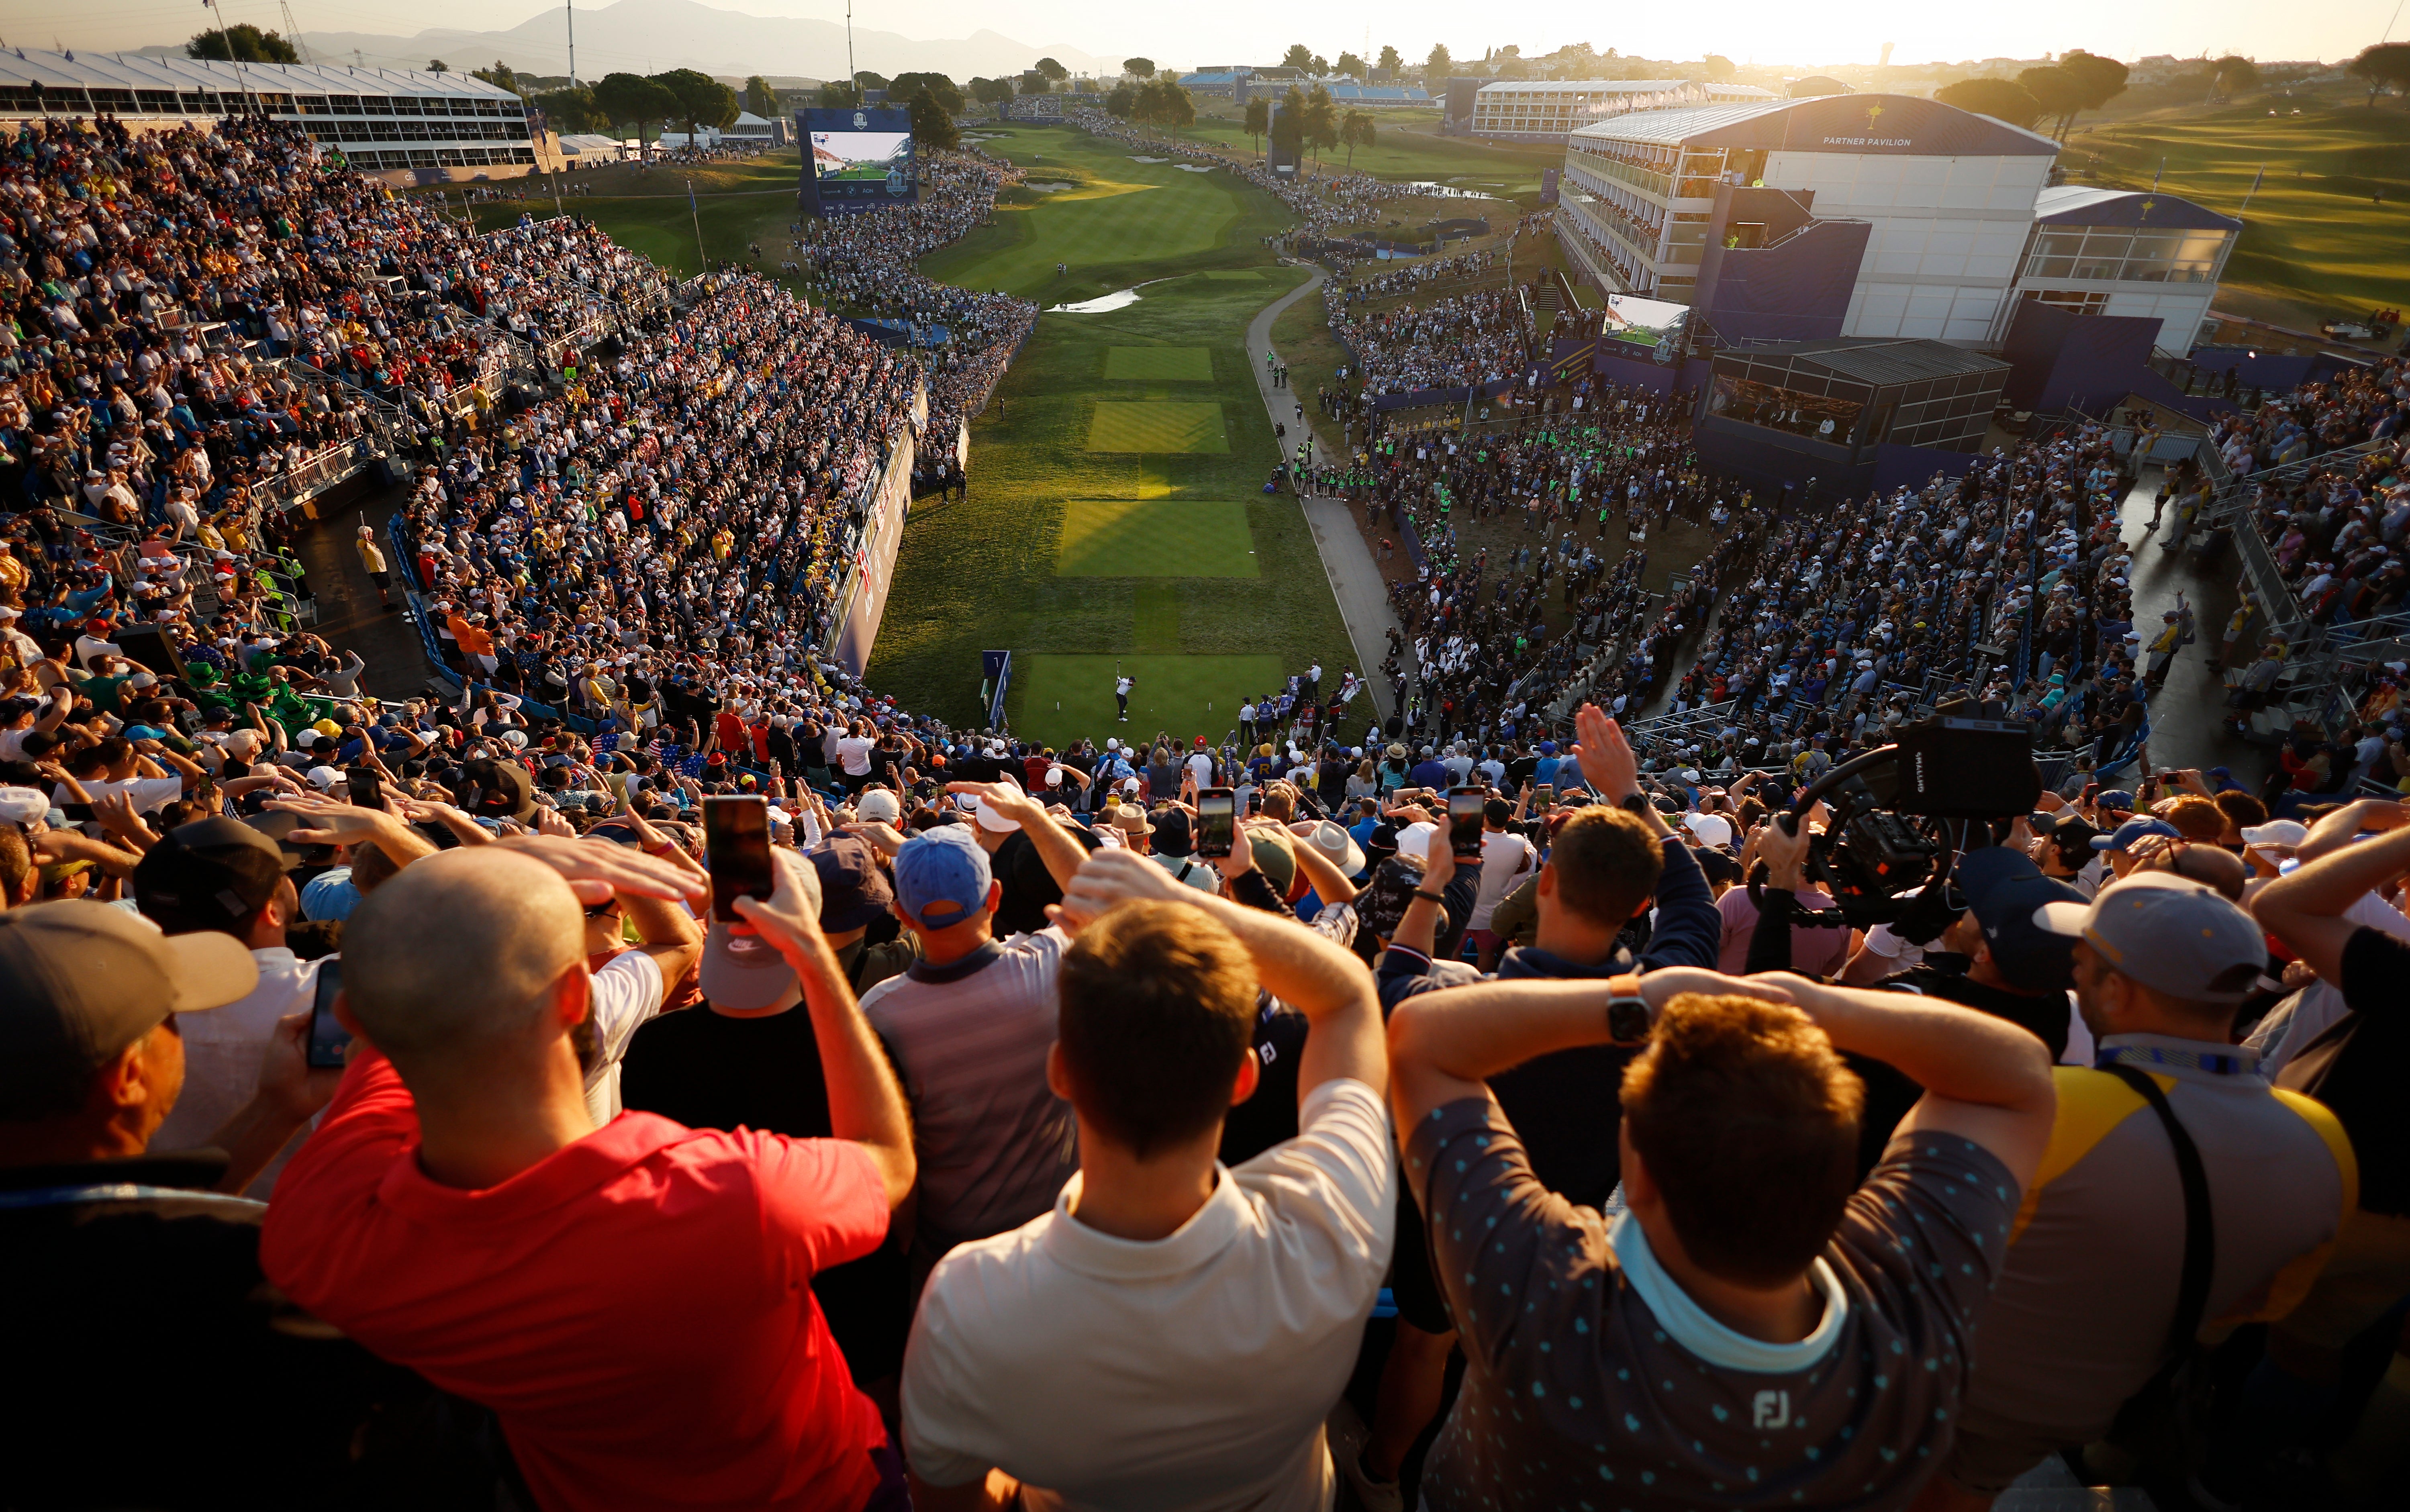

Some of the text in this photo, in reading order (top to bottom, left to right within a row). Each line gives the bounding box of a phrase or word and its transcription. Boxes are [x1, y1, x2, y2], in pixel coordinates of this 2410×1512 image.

[1823, 137, 1865, 145] PARTNER
[404, 171, 416, 181] citi
[865, 586, 874, 623] AON
[993, 657, 999, 668] 1
[1259, 764, 1270, 775] R
[1915, 752, 1924, 792] SMALLHD
[1753, 1390, 1789, 1430] FJ
